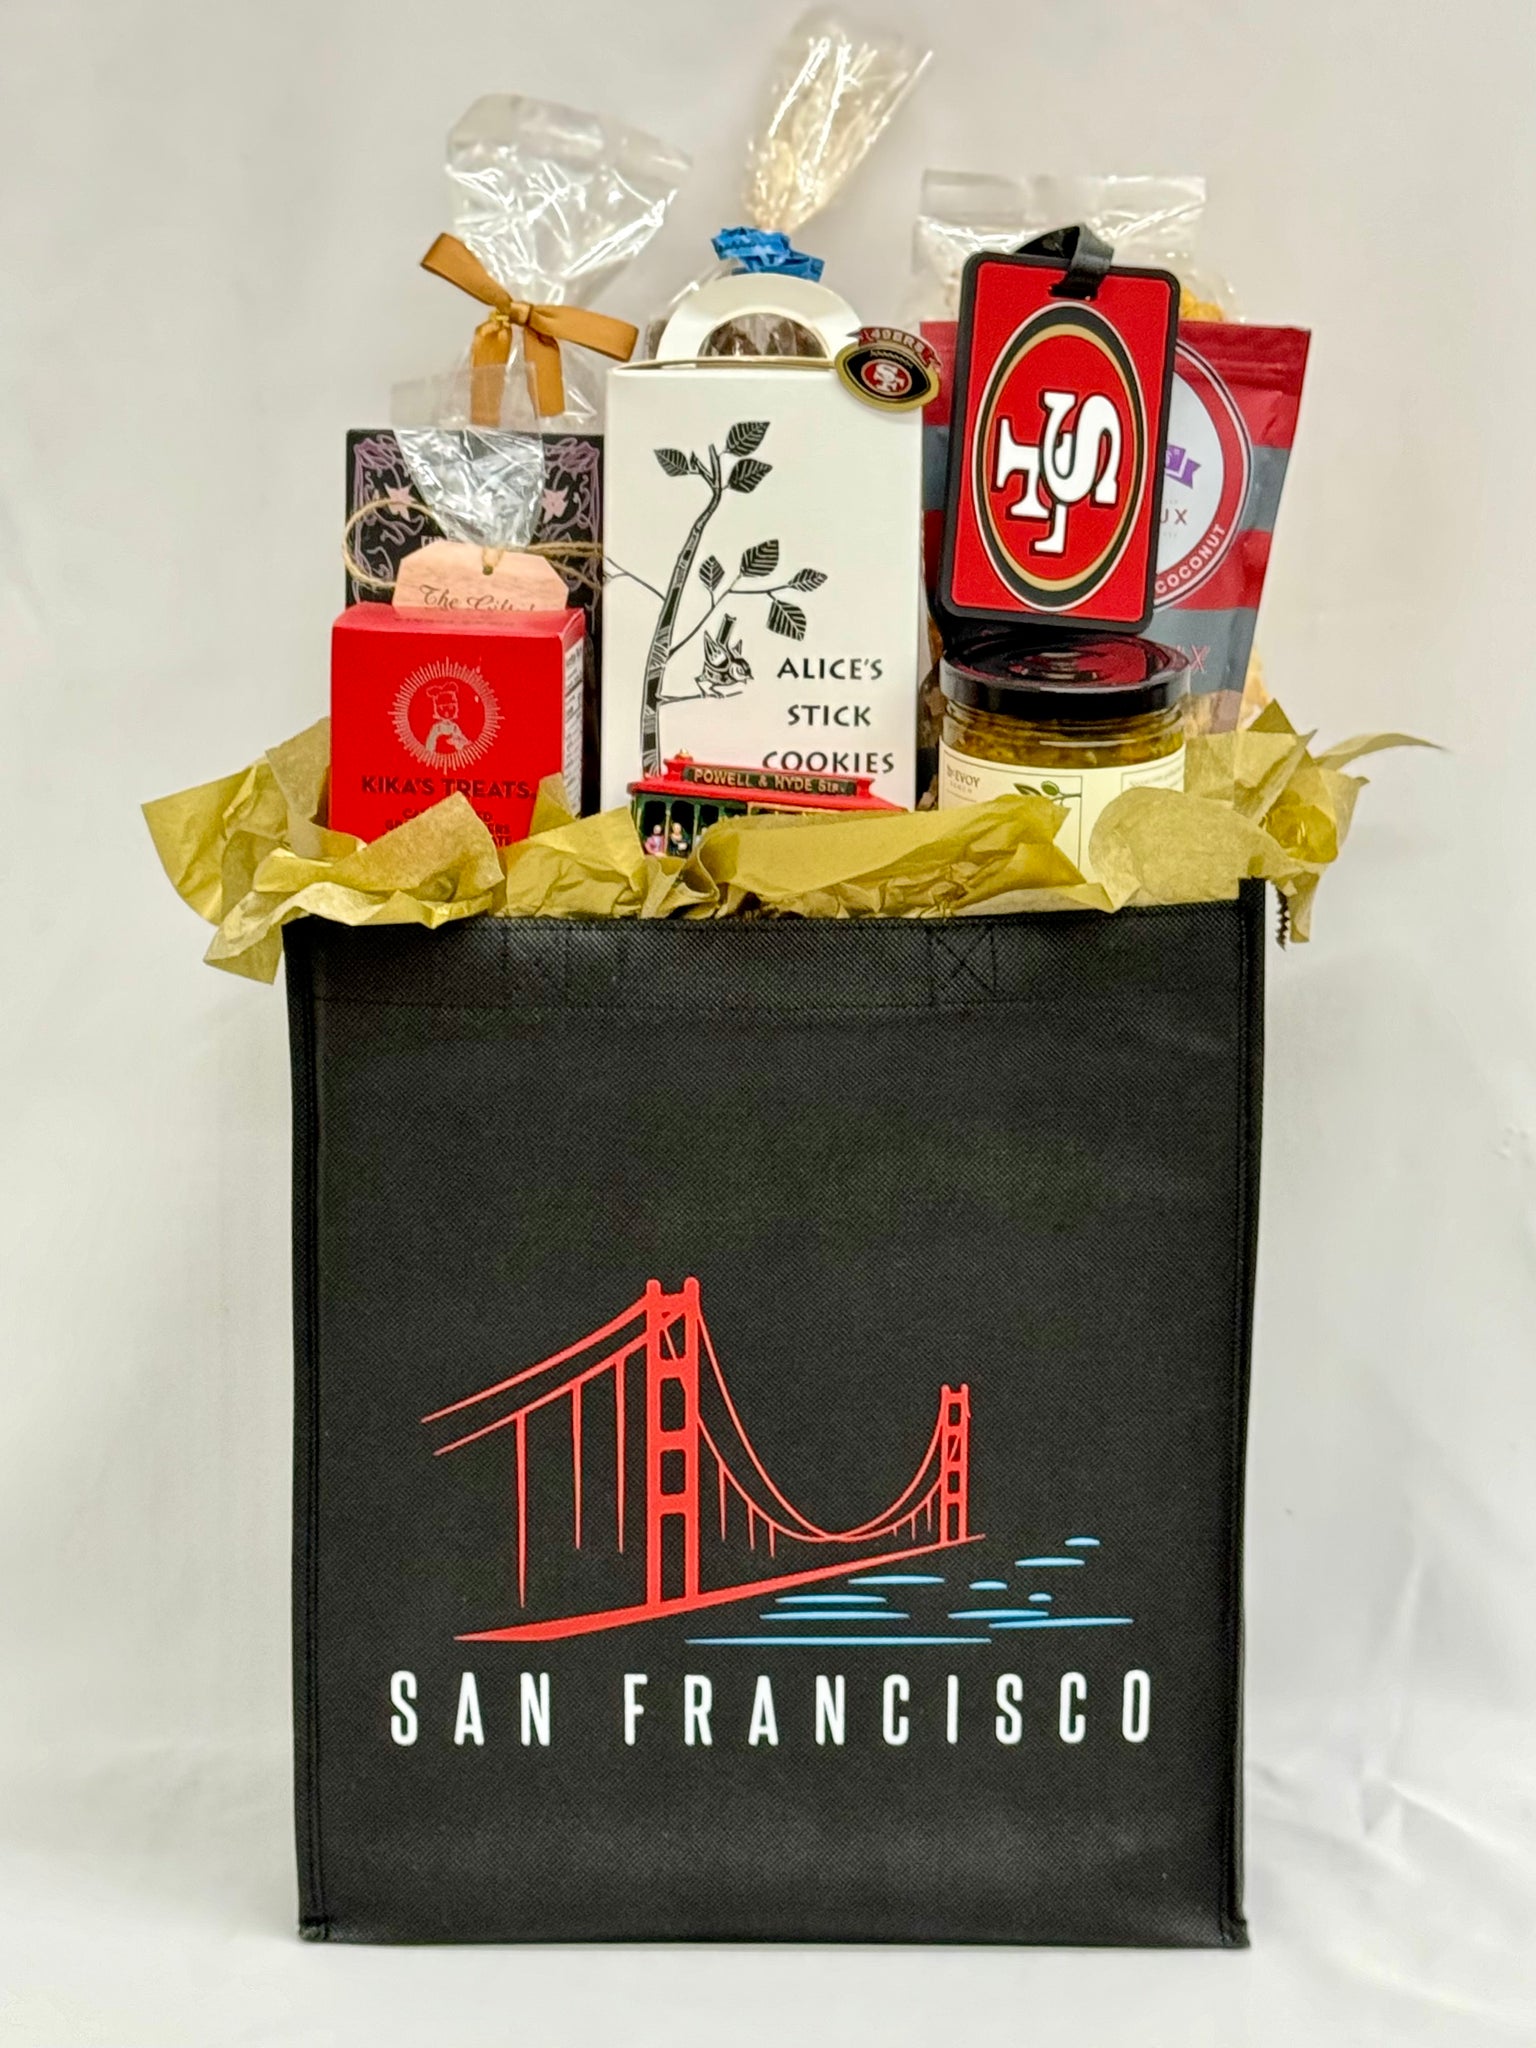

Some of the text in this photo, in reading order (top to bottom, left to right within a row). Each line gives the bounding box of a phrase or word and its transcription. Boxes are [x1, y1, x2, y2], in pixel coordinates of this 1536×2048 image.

[870, 327, 926, 354] 49ERS
[995, 391, 1123, 555] SF
[1154, 523, 1226, 595] COCONUT
[419, 584, 459, 610] The
[777, 657, 883, 680] ALICE'S
[787, 704, 871, 726] STICK
[762, 751, 894, 773] COOKIES
[361, 775, 435, 796] KIKA'S
[694, 768, 751, 787] POWELL
[758, 774, 767, 788] &
[775, 774, 813, 792] HYDE
[389, 1668, 1151, 1747] SAN FRANCISCO
